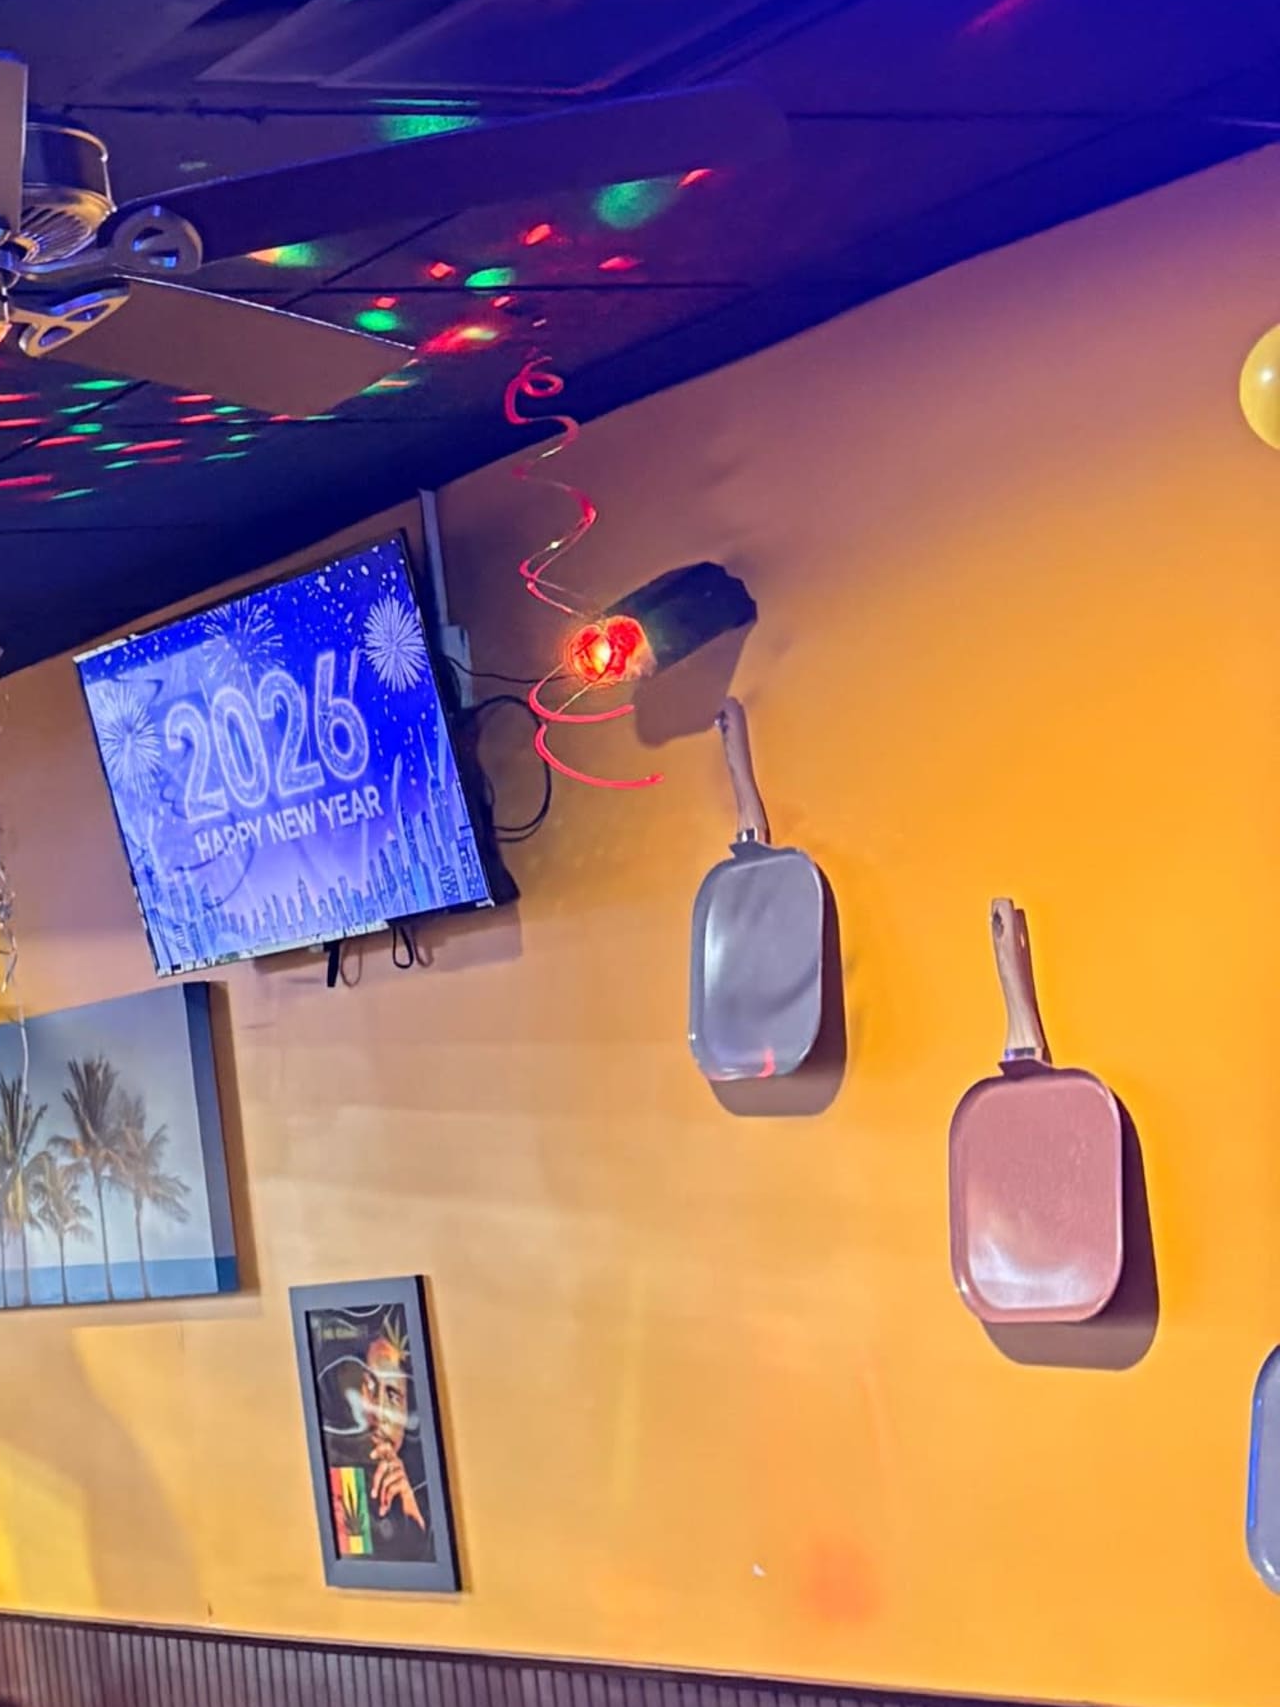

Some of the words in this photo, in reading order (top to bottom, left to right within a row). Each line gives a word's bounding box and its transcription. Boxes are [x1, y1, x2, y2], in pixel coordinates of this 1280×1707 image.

[164, 649, 370, 824] 2026
[193, 815, 263, 862] HAPPY
[266, 799, 317, 844] NEW
[318, 783, 385, 830] YEAR
